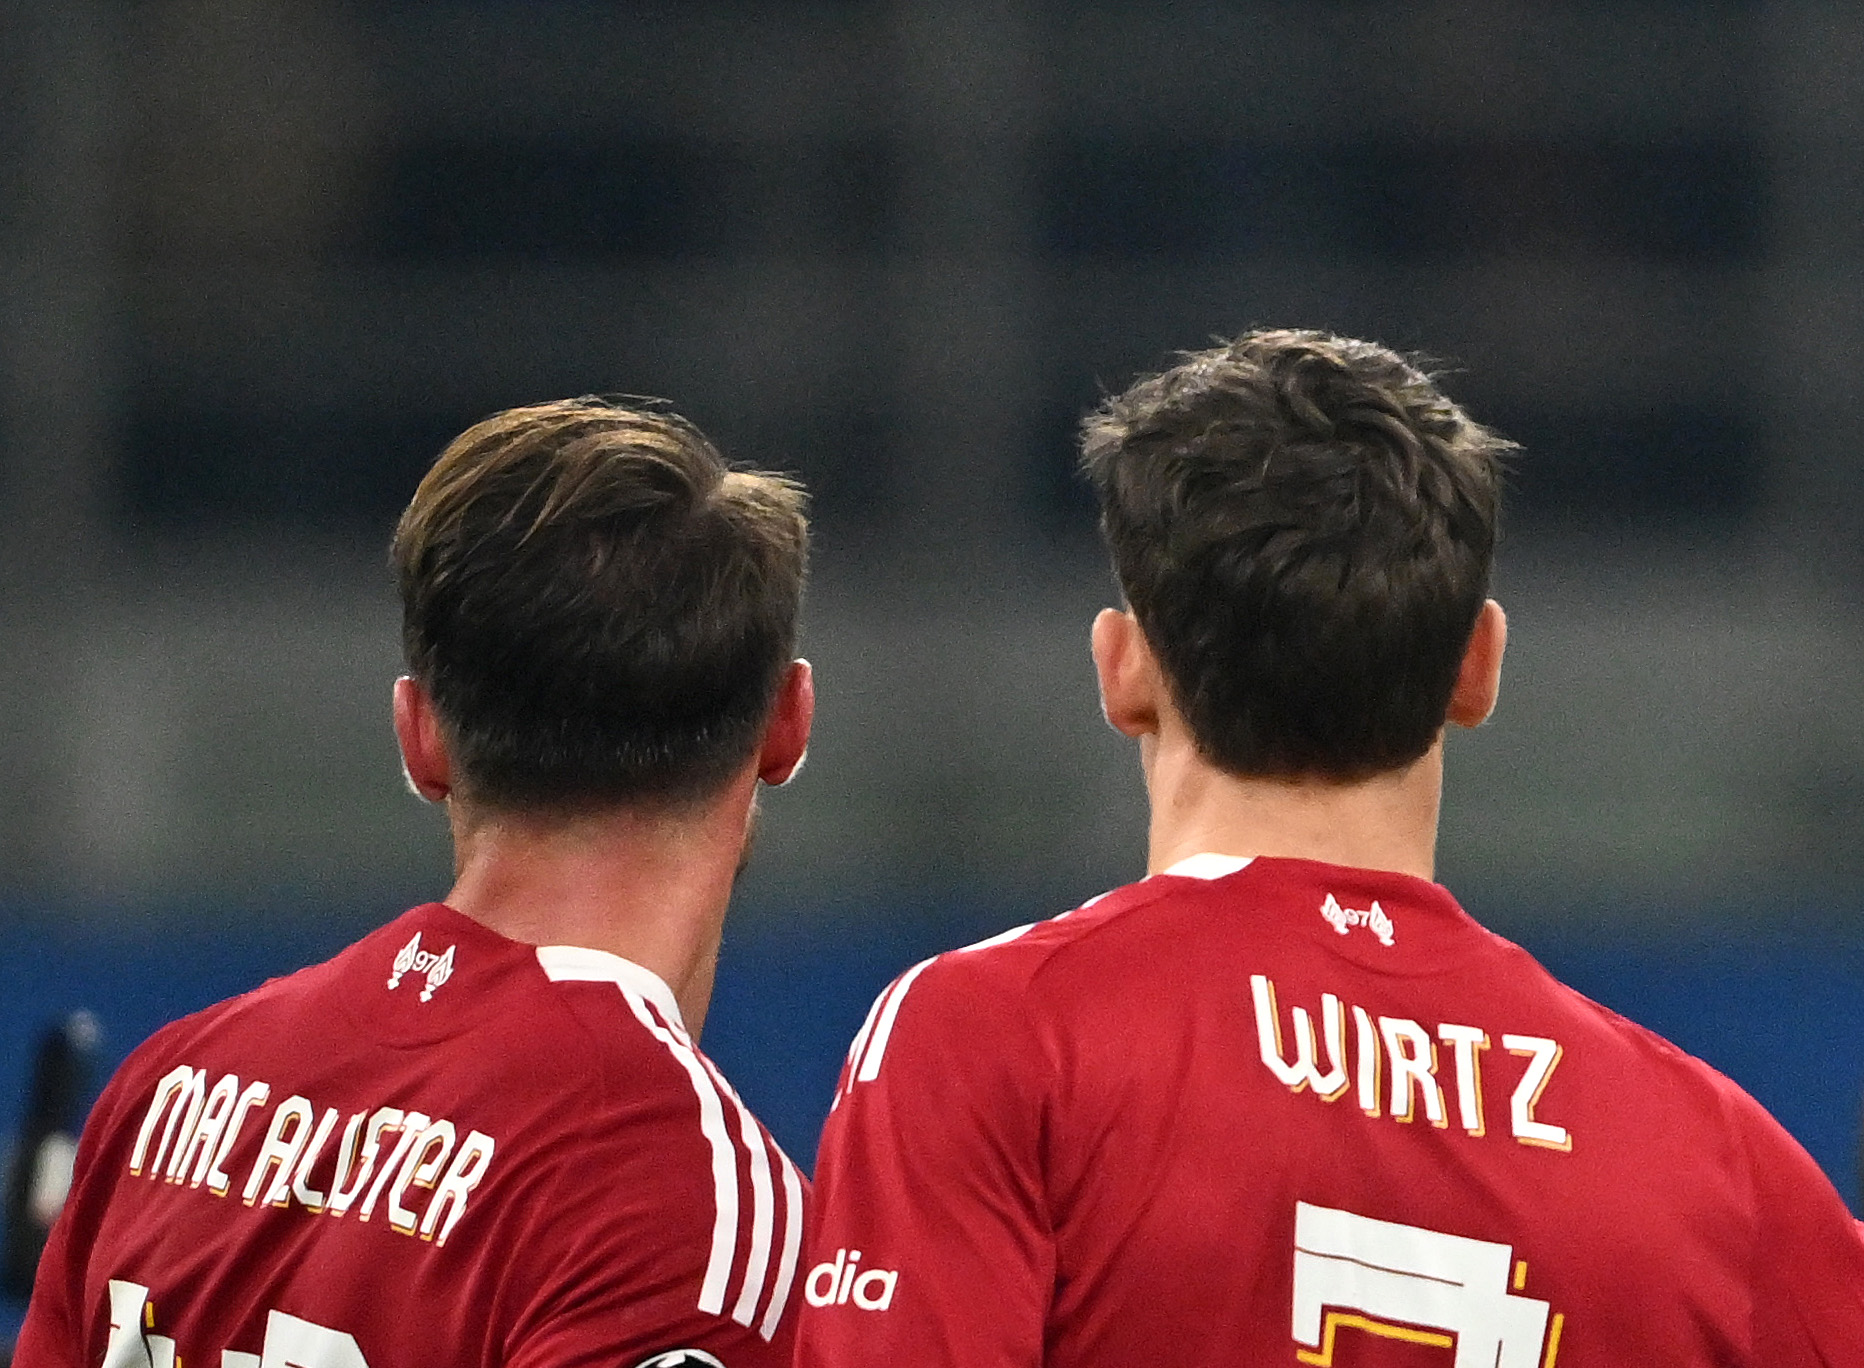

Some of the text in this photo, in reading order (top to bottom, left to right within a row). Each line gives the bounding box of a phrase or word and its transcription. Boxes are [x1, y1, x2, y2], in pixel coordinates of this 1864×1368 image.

[411, 950, 440, 974] 97
[1250, 974, 1573, 1152] WIRTZ
[130, 1064, 270, 1197] MAC
